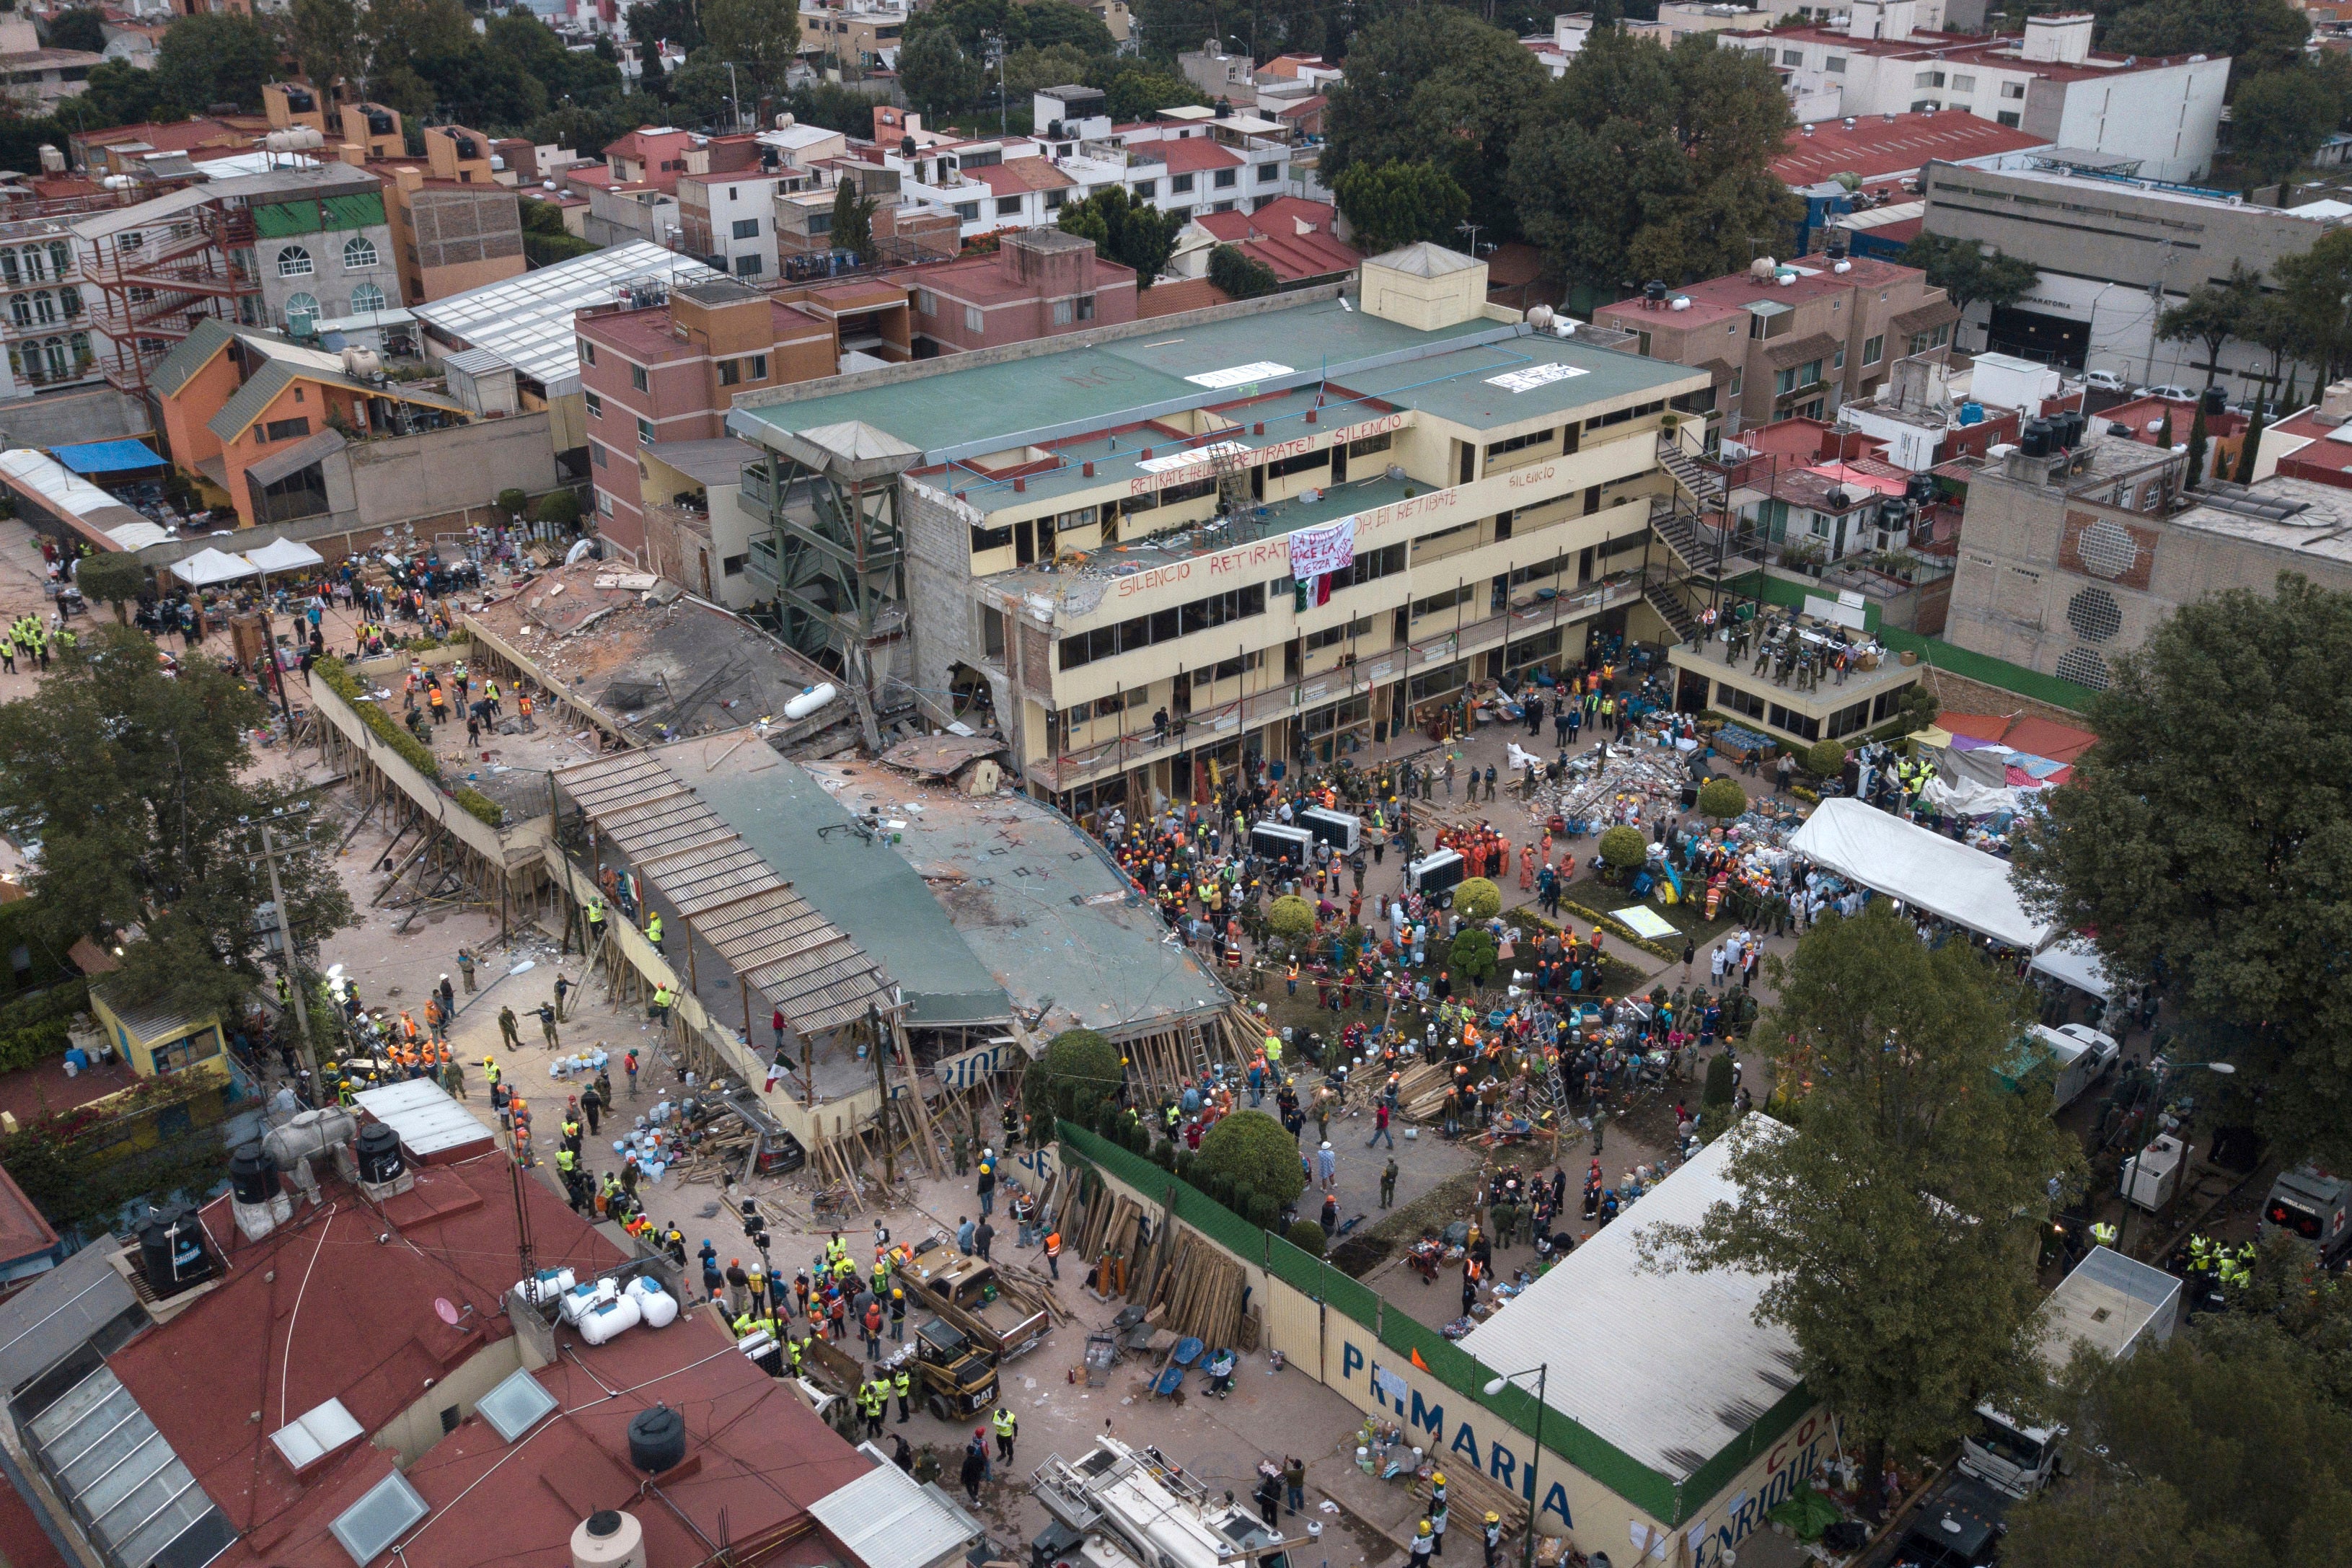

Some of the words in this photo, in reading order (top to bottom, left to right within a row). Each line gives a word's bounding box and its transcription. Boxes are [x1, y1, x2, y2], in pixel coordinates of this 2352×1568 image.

[2027, 295, 2071, 309] PARATORIA
[1334, 415, 1401, 444] SILENCIO
[1509, 467, 1555, 488] SILENCIO
[1291, 547, 1317, 563] HACE
[1321, 542, 1336, 555] LA
[1292, 534, 1305, 550] LA
[1118, 563, 1190, 596] SILENCIO
[1210, 541, 1290, 575] RETIRAT
[1291, 558, 1331, 576] FUERZA
[2280, 1196, 2315, 1215] AMBULANCIA
[973, 1386, 992, 1408] CAT
[1695, 1431, 1827, 1568] ENRIQUE
